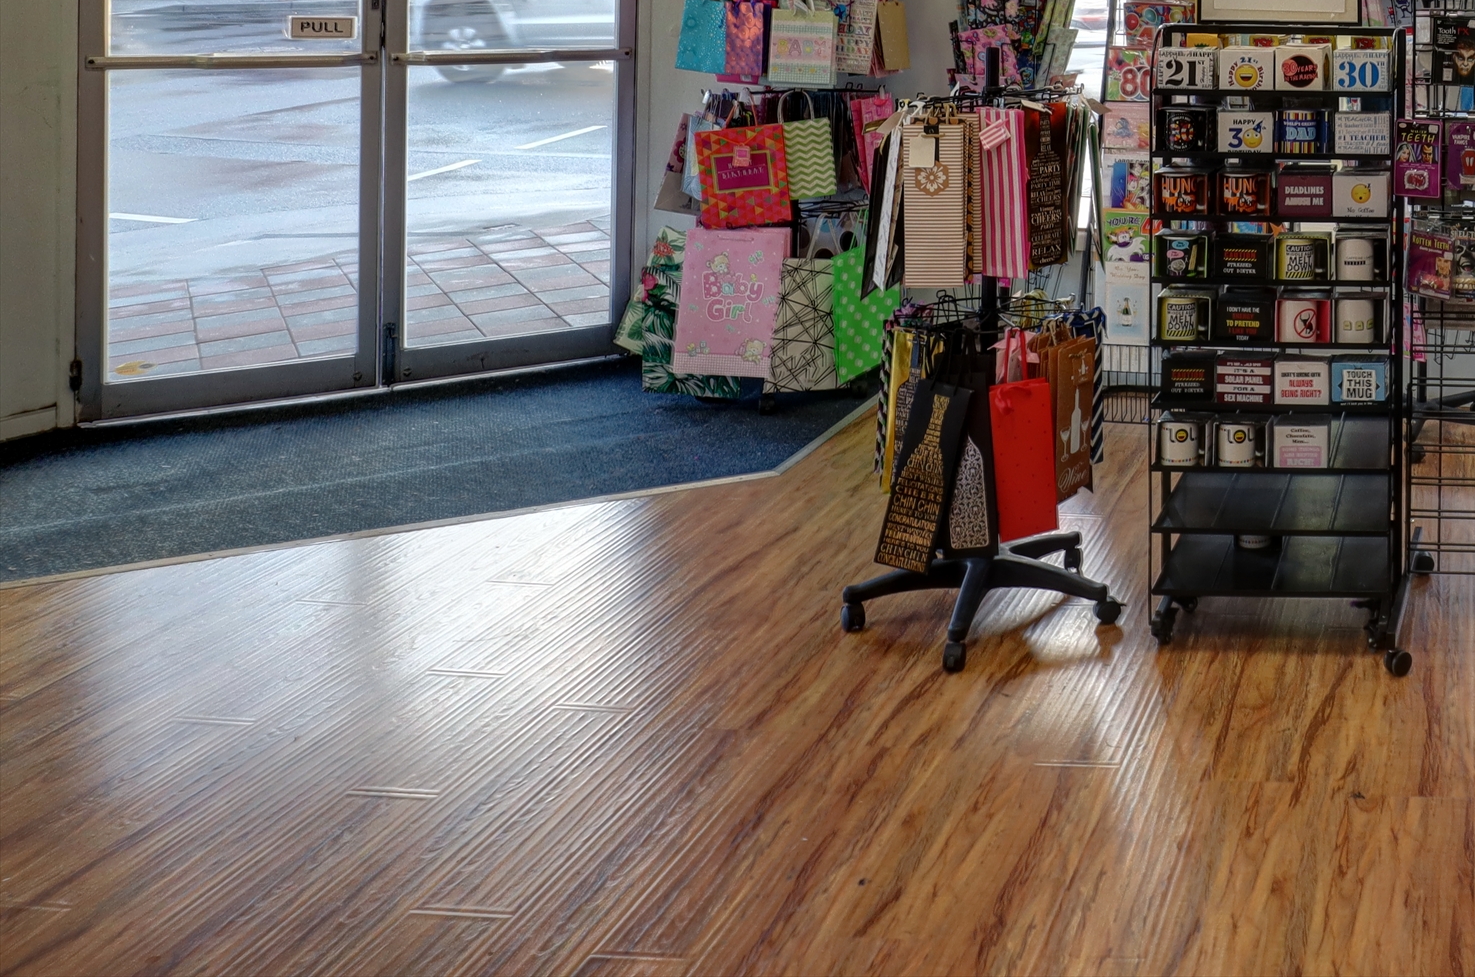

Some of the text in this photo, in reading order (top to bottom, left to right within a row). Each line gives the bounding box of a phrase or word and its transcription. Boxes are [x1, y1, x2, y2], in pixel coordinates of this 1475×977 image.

[300, 20, 345, 34] PULL
[1437, 27, 1457, 35] Tooth
[776, 38, 828, 58] BABY
[1165, 59, 1198, 87] 21
[1338, 61, 1379, 88] 30
[1285, 126, 1317, 141] DAD
[1401, 132, 1436, 143] TEETH
[1039, 165, 1061, 174] PARTY
[1284, 186, 1324, 194] DEADLINES
[1312, 197, 1324, 205] ME
[1412, 235, 1432, 246] ROTTEN
[1032, 244, 1061, 257] RELAX
[1289, 256, 1312, 264] MELT
[703, 272, 764, 303] Baby
[705, 299, 753, 322] Girl
[1225, 375, 1263, 384] SOLAR PANEL
[1346, 370, 1372, 379] TOUCH
[1346, 379, 1372, 387] THIS
[1224, 394, 1263, 402] SEX MACHINE
[1281, 389, 1322, 398] BEING RIGHT?
[1346, 388, 1372, 399] MUG
[893, 494, 940, 515] CHIN CHIN
[880, 544, 928, 563] CHIN CHIN
